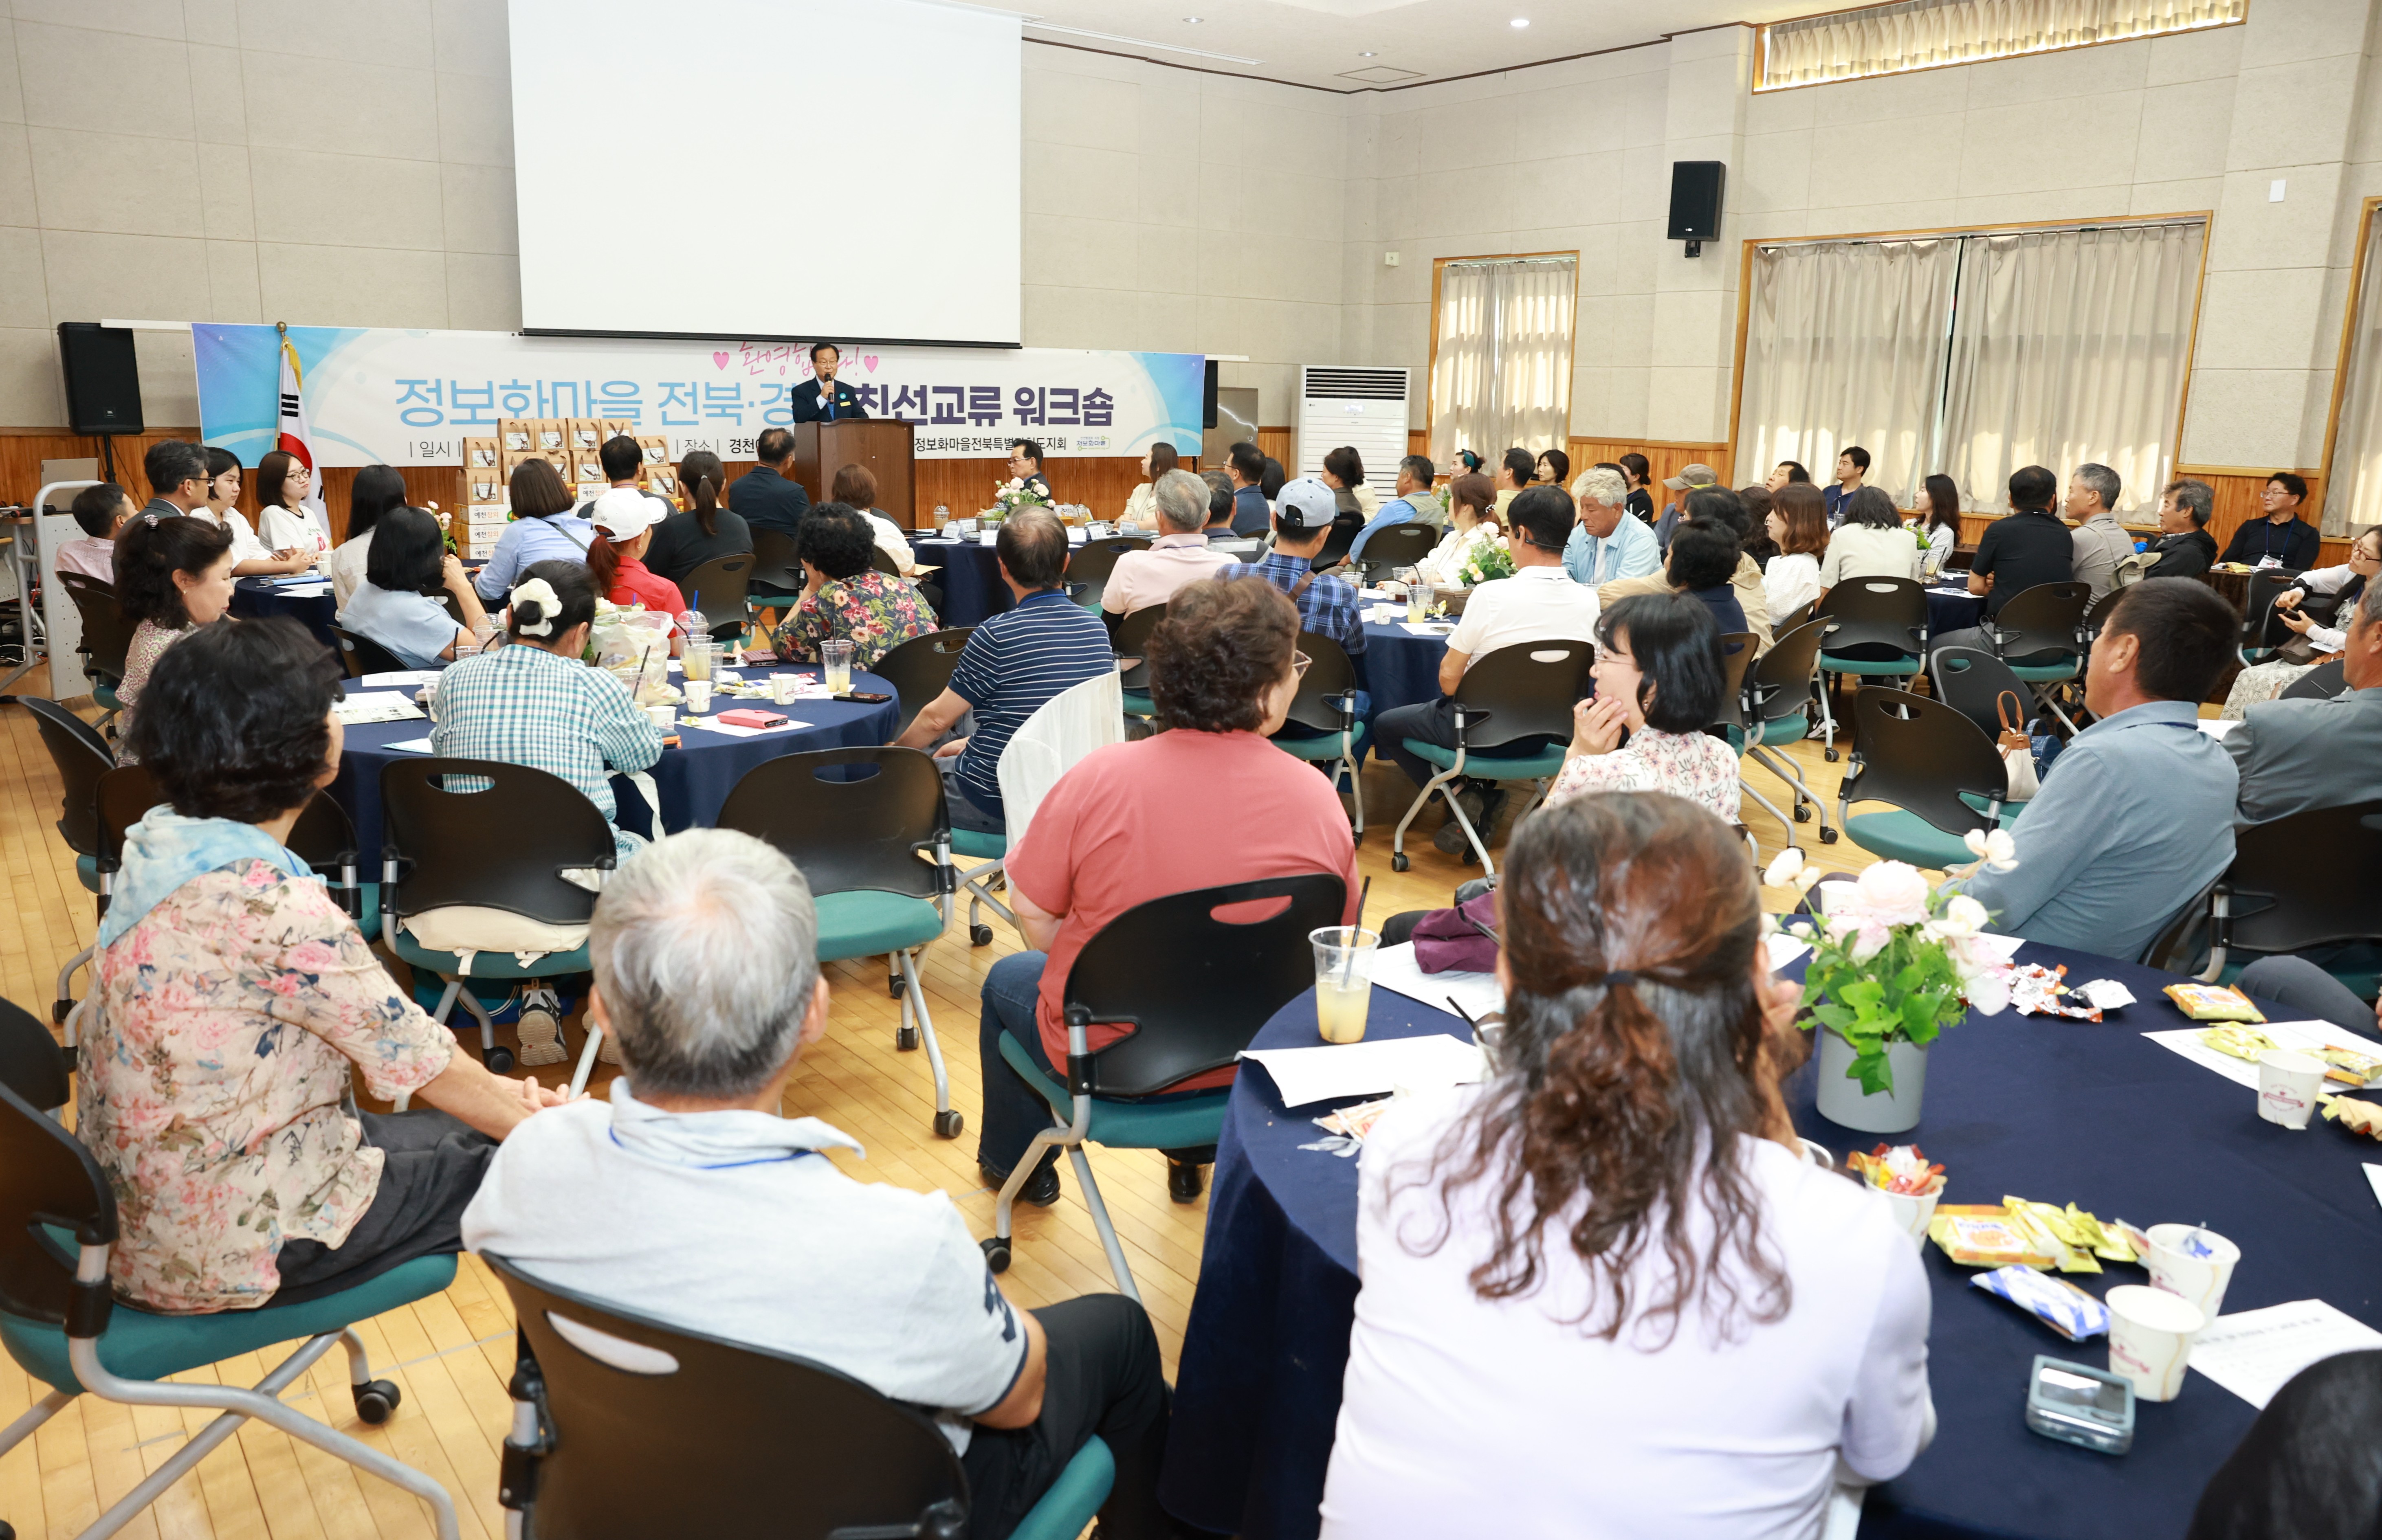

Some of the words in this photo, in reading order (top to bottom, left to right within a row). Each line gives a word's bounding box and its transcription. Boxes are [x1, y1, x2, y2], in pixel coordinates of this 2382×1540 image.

[739, 341, 859, 376] 환영합다!
[395, 378, 643, 427] 정보화마을
[658, 381, 793, 426] 전북·경
[1013, 387, 1114, 426] 워크숍
[420, 441, 450, 458] 일시
[730, 439, 759, 454] 경천
[914, 437, 1066, 452] 정보화마을전북특별도지회
